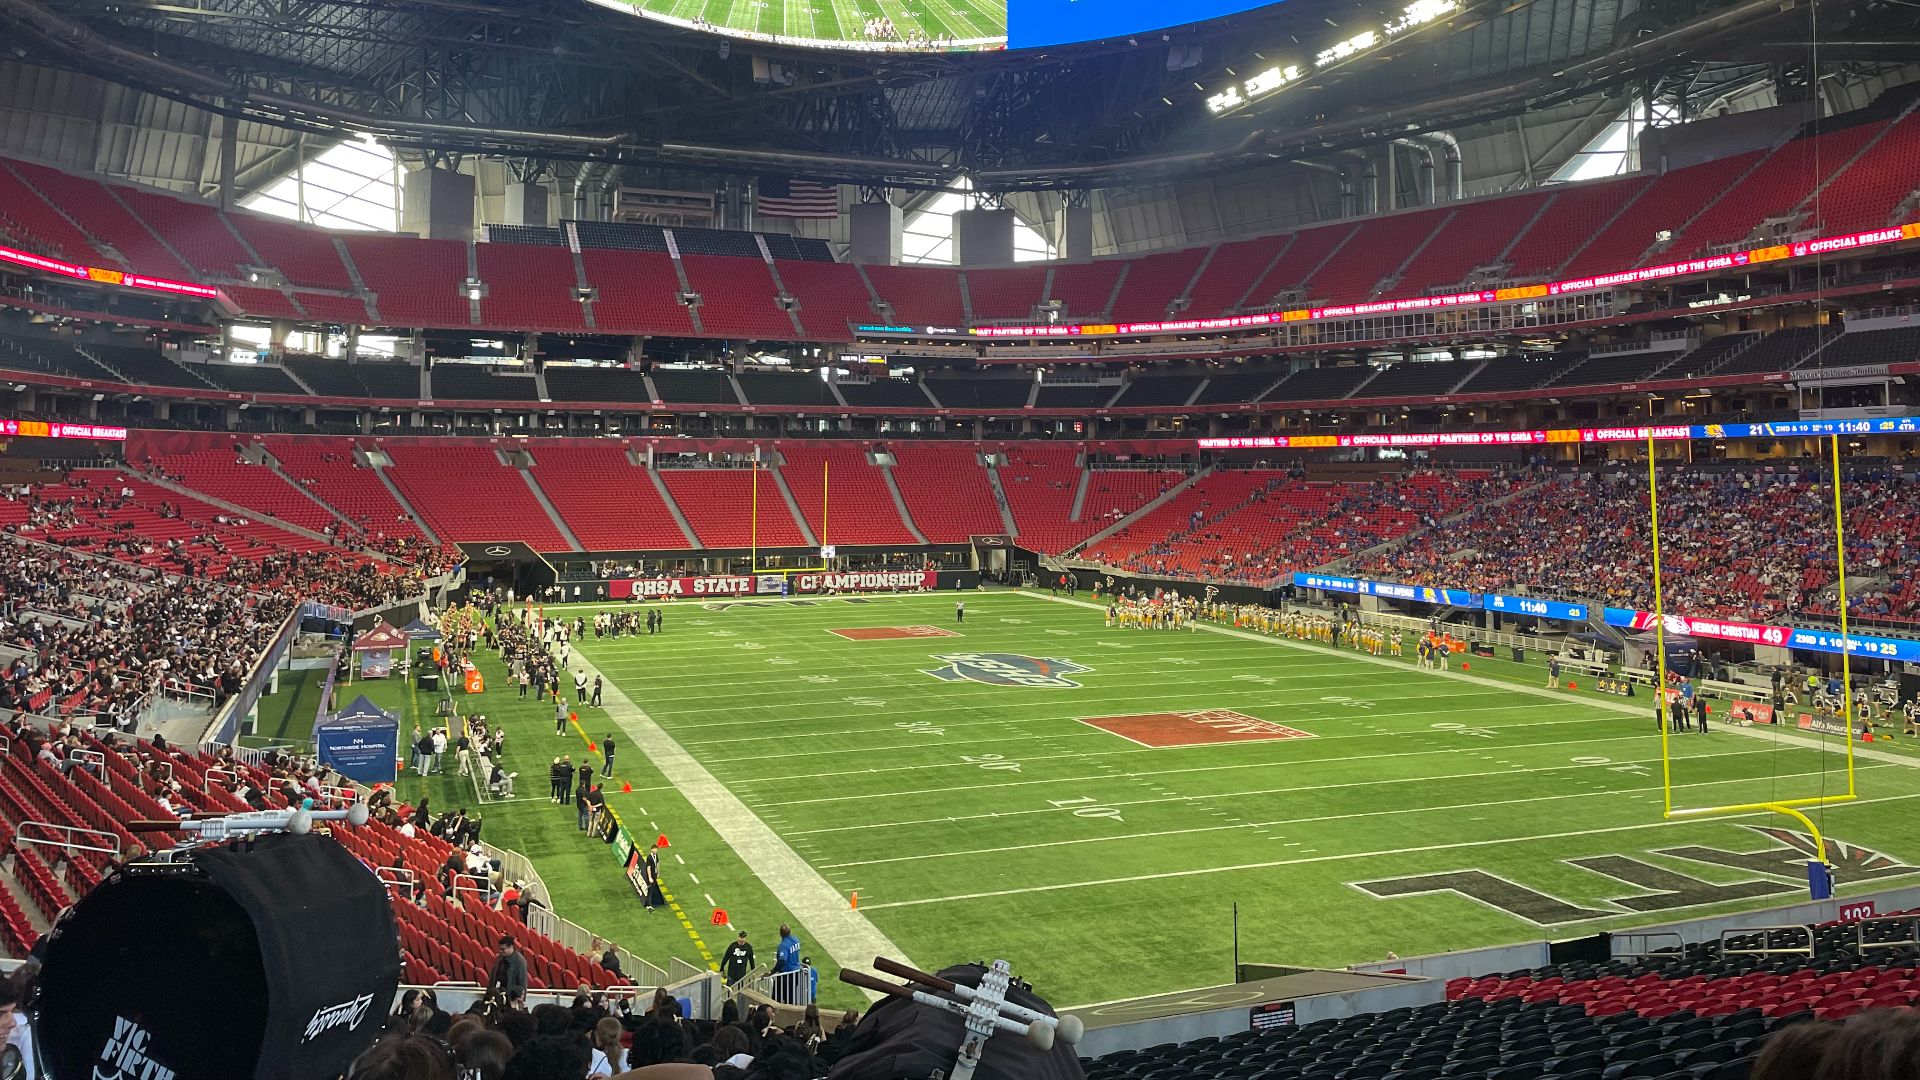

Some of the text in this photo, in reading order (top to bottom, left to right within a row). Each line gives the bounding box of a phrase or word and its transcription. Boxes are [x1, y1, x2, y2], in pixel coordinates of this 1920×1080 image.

[1810, 229, 1902, 252] OFFICIAL BREAKF
[1561, 256, 1732, 291] OFFICIAL BREAKFAST PARTNER OF THE GHSA
[1323, 294, 1481, 317] OFFICIAL BREAKFAST PARTNER OF THE GHSA
[1130, 324, 1160, 332] OFFICIAL
[1162, 322, 1200, 331] BREAKFAST
[1201, 320, 1231, 328] PARTNER
[1252, 316, 1270, 324] GHSA
[1851, 366, 1887, 376] Stadium
[62, 425, 126, 438] OFFICIAL BREAKFAST
[1749, 425, 1762, 434] 21
[1838, 422, 1870, 432] 11:40
[1879, 422, 1894, 430] :25
[1899, 423, 1915, 431] 4TH
[1353, 433, 1532, 444] OFFICIAL BREAKFAST PARTNER OF THE GHSA
[1597, 428, 1690, 439] OFFICIAL BREAKFAST
[1200, 439, 1230, 447] PARTNER
[1254, 438, 1276, 446] GHSA
[631, 572, 926, 596] GHSA STATE CHAMPIONSHIP
[1359, 582, 1369, 593] 21
[1520, 601, 1548, 613] 11:40
[1569, 608, 1580, 617] :25
[1691, 621, 1759, 640] HEBRON CHRISTIAN
[1762, 629, 1783, 643] 49
[1795, 634, 1842, 648] 2ND & 10
[1864, 642, 1878, 652] 19
[1880, 643, 1898, 656] 25
[471, 680, 480, 691] G
[894, 720, 946, 736] 30
[1811, 720, 1862, 735] Alfa Insurace
[959, 753, 1021, 773] 20
[1046, 796, 1125, 822] 10
[714, 911, 722, 924] G
[1844, 905, 1871, 920] 102
[113, 1014, 152, 1055] VIC
[100, 1036, 177, 1080] FIRTH
